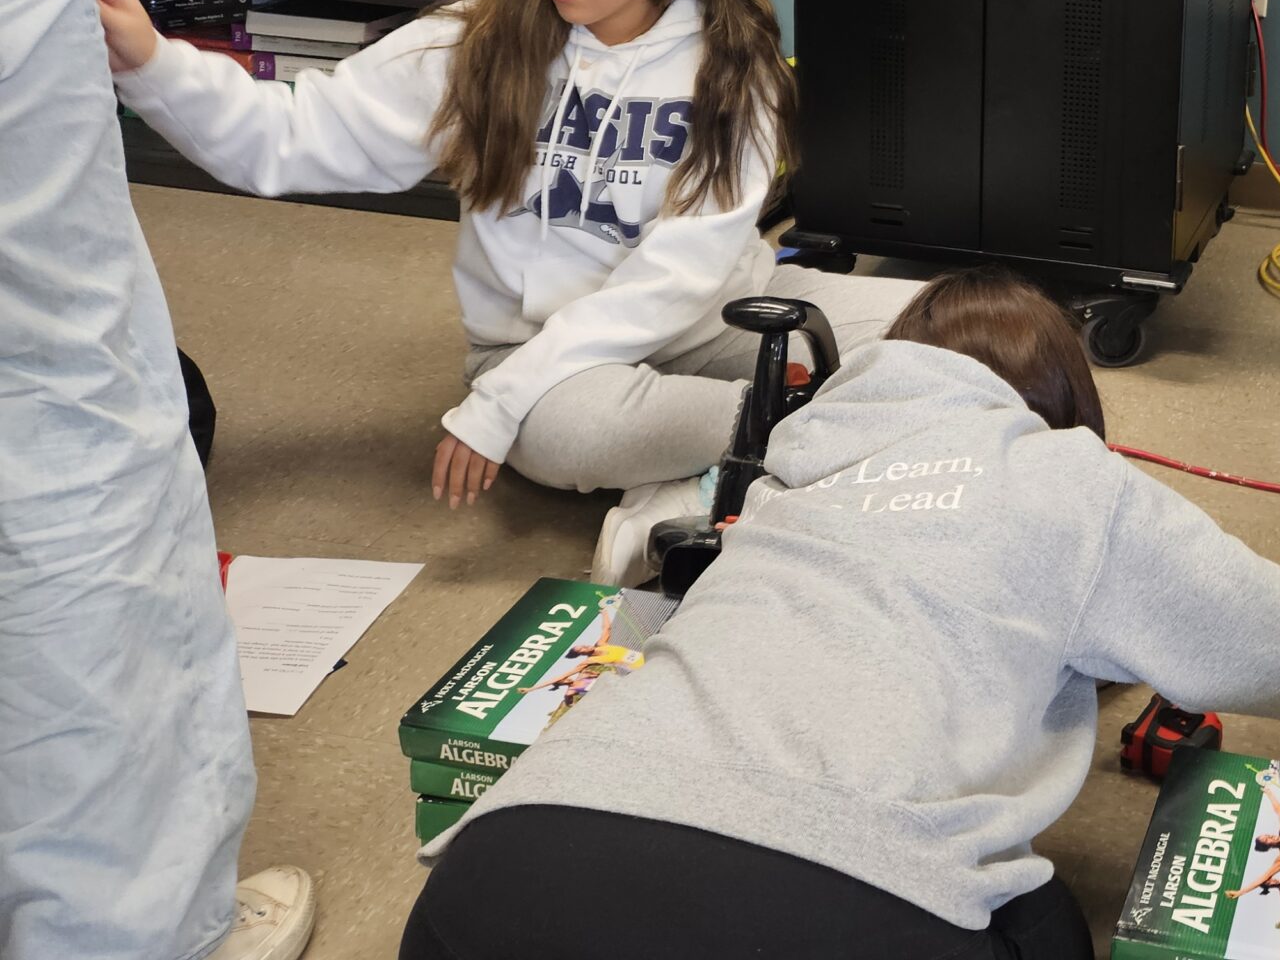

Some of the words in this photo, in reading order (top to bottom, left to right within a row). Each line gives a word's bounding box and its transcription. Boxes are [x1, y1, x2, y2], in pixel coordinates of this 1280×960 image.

[536, 87, 694, 164] ASIS
[534, 151, 577, 169] IGH
[852, 456, 984, 484] Learn,
[861, 484, 964, 513] Lead
[434, 678, 457, 699] HOLT
[453, 644, 494, 680] McDOUGAL
[451, 661, 498, 702] LARSON
[455, 621, 573, 720] ALGEBRA
[547, 603, 588, 620] 2
[448, 738, 480, 749] LARSON
[450, 778, 494, 798] ALG
[461, 772, 493, 783] LARSON
[1139, 881, 1155, 905] HOLT
[1148, 831, 1171, 881] McDOUGAL
[1171, 803, 1241, 934] ALGEBRA
[1207, 779, 1246, 800] 2
[1160, 855, 1187, 908] LARSON
